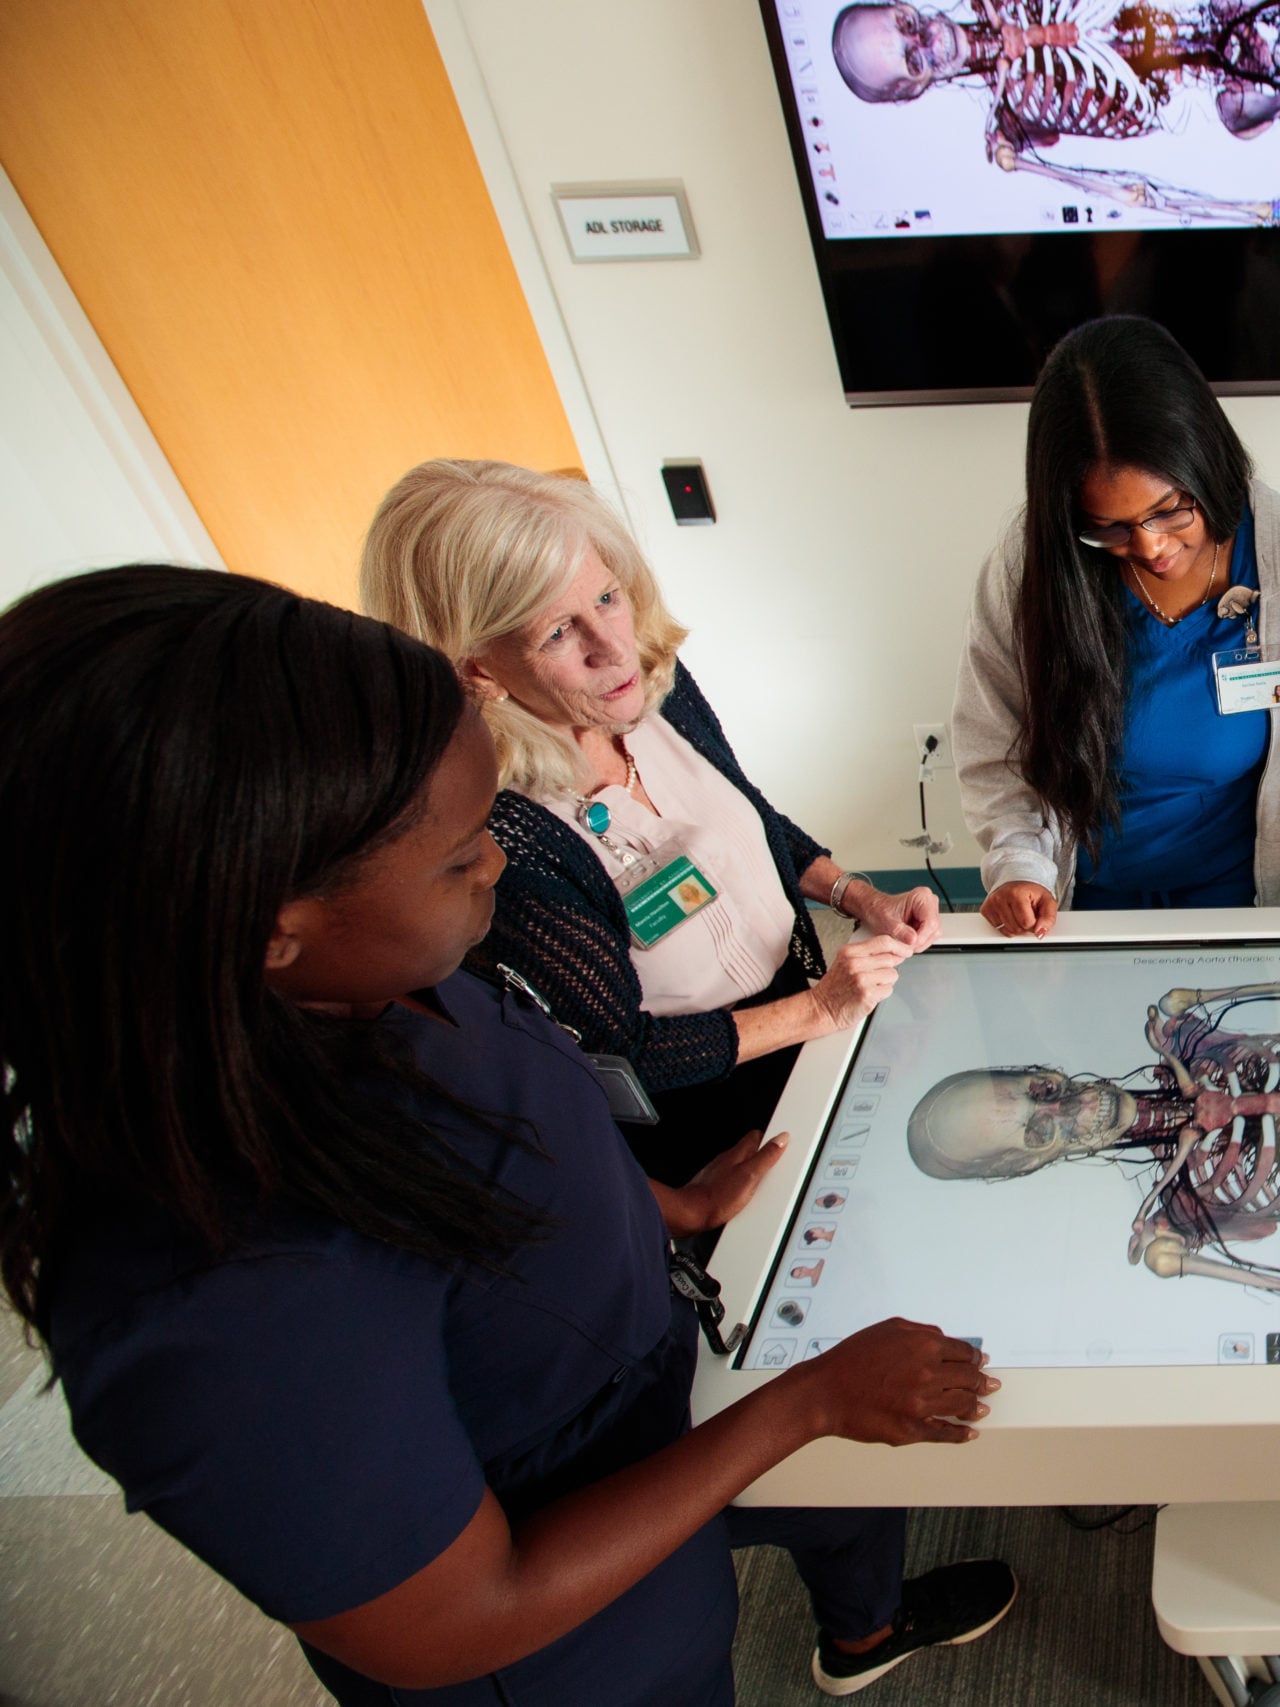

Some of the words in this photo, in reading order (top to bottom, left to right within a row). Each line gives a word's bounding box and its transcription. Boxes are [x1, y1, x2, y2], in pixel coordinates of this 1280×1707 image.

[585, 220, 608, 234] ADL
[611, 219, 663, 233] STORAGE
[1133, 957, 1195, 965] Descending
